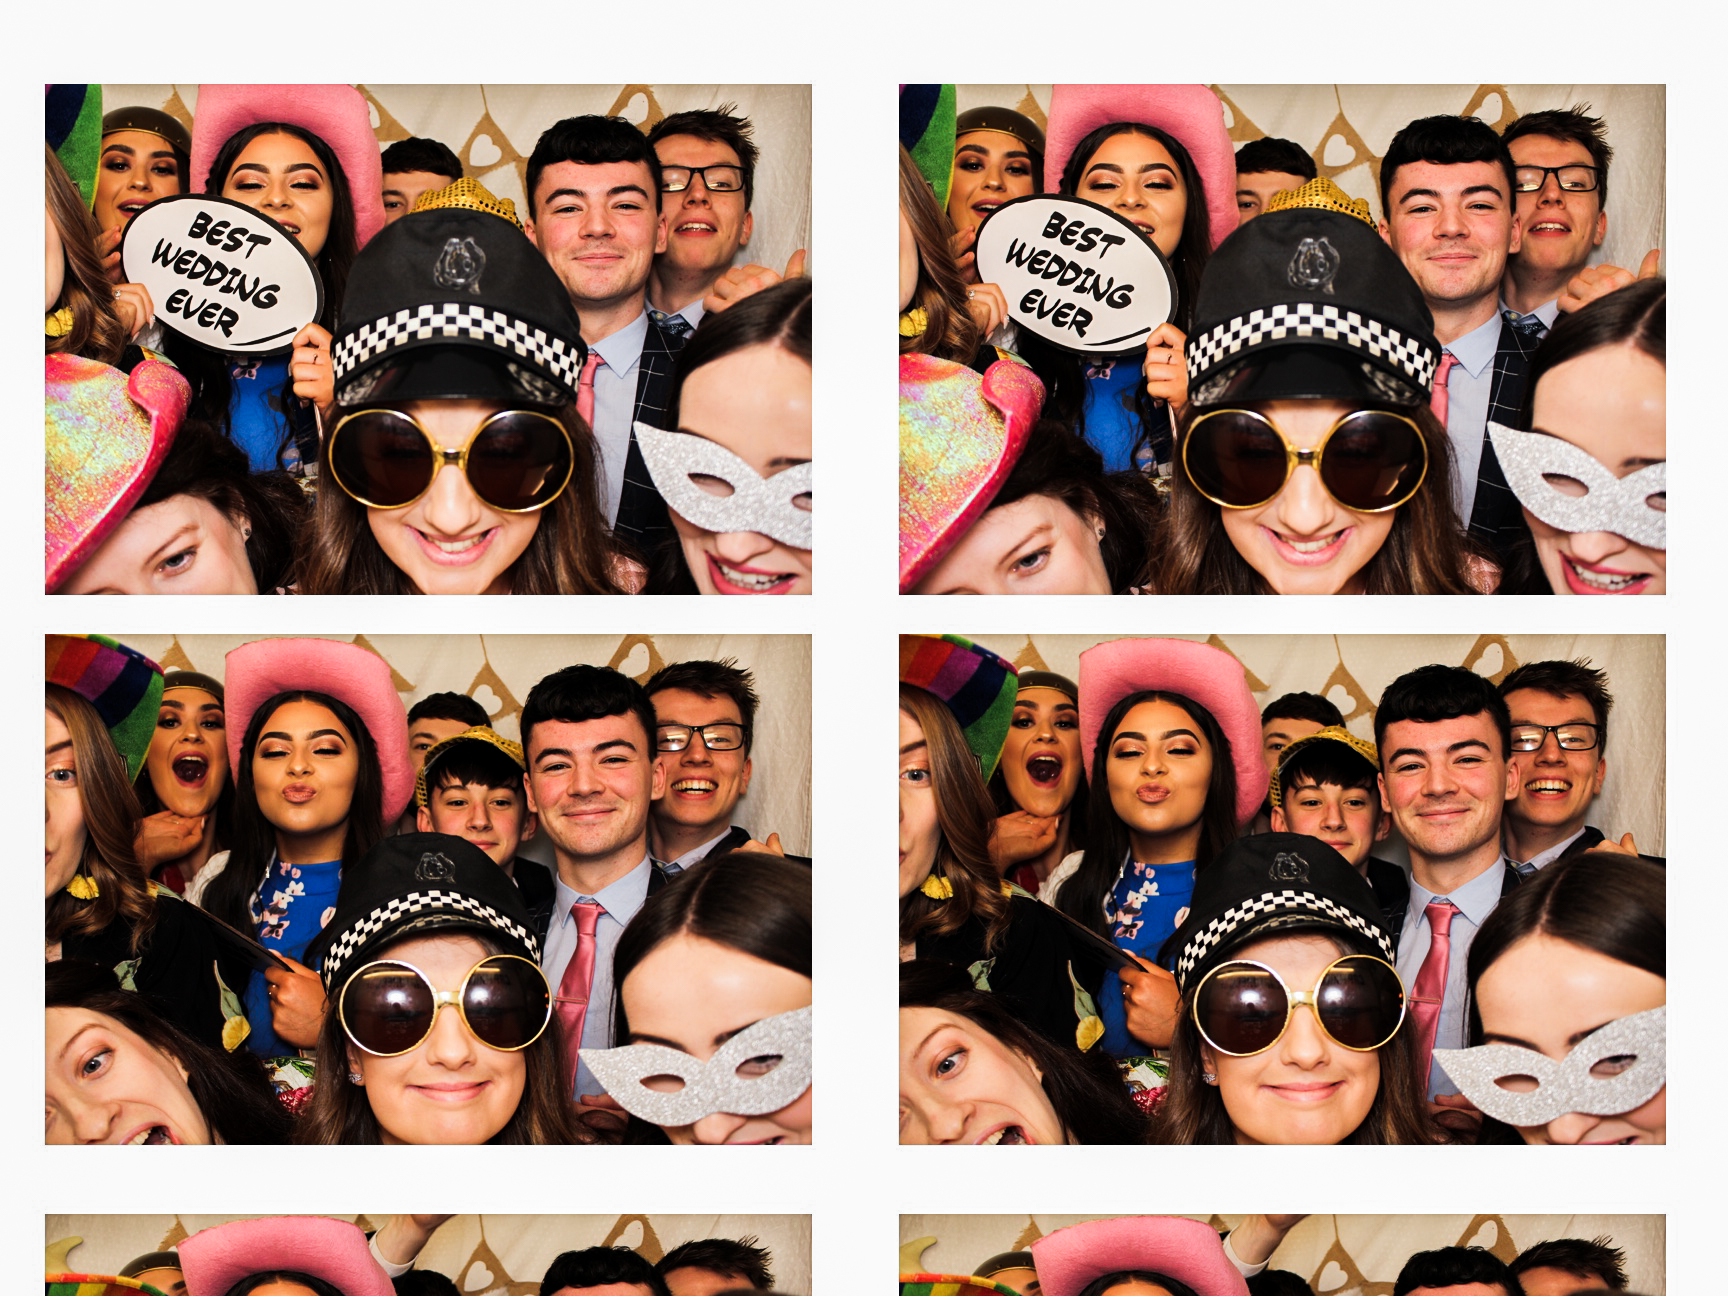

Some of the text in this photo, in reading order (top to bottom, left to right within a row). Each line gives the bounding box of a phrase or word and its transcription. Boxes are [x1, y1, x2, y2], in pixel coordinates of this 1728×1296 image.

[188, 211, 272, 260] BEST
[1042, 211, 1126, 260] BEST
[151, 238, 281, 310] WEDDING
[1005, 238, 1135, 310] WEDDING
[165, 288, 240, 339] EVER
[1019, 288, 1094, 339] EVER
